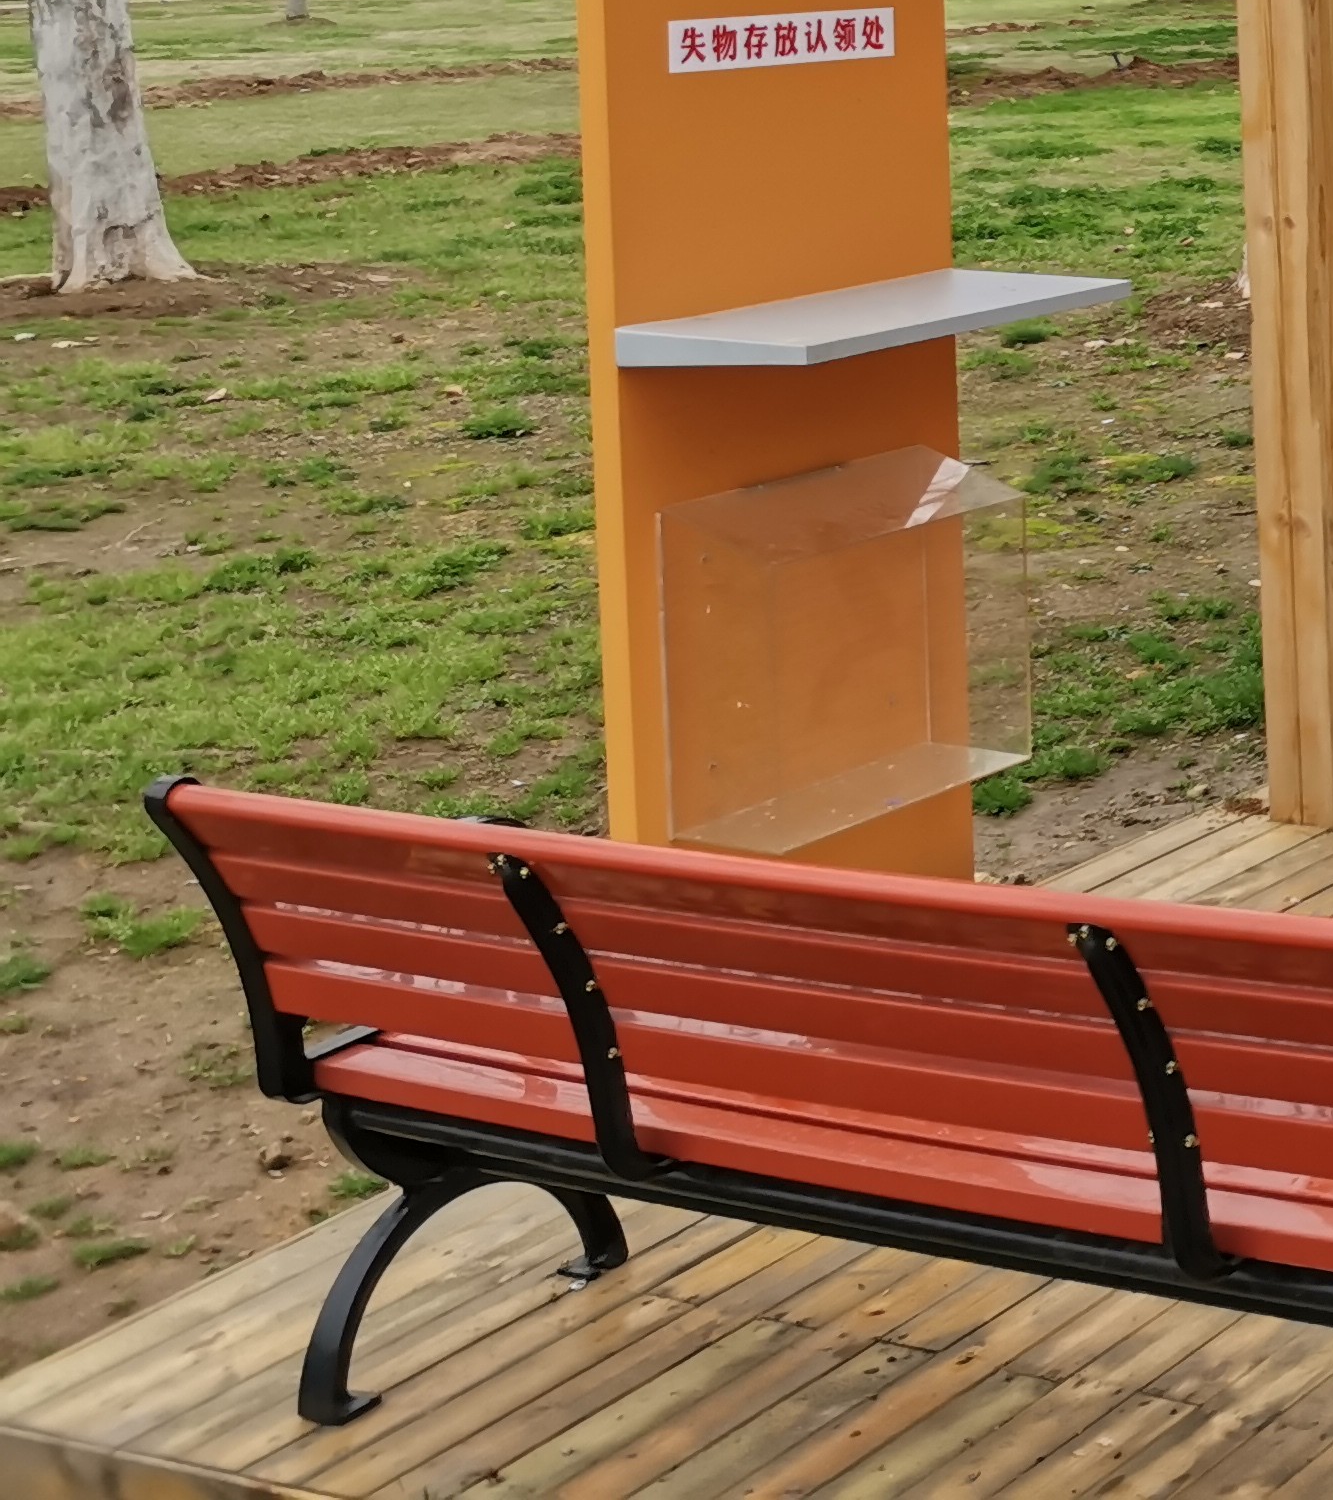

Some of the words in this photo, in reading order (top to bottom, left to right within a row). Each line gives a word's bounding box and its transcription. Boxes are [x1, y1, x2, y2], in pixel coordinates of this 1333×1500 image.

[680, 15, 885, 64] 失物存放认领处
